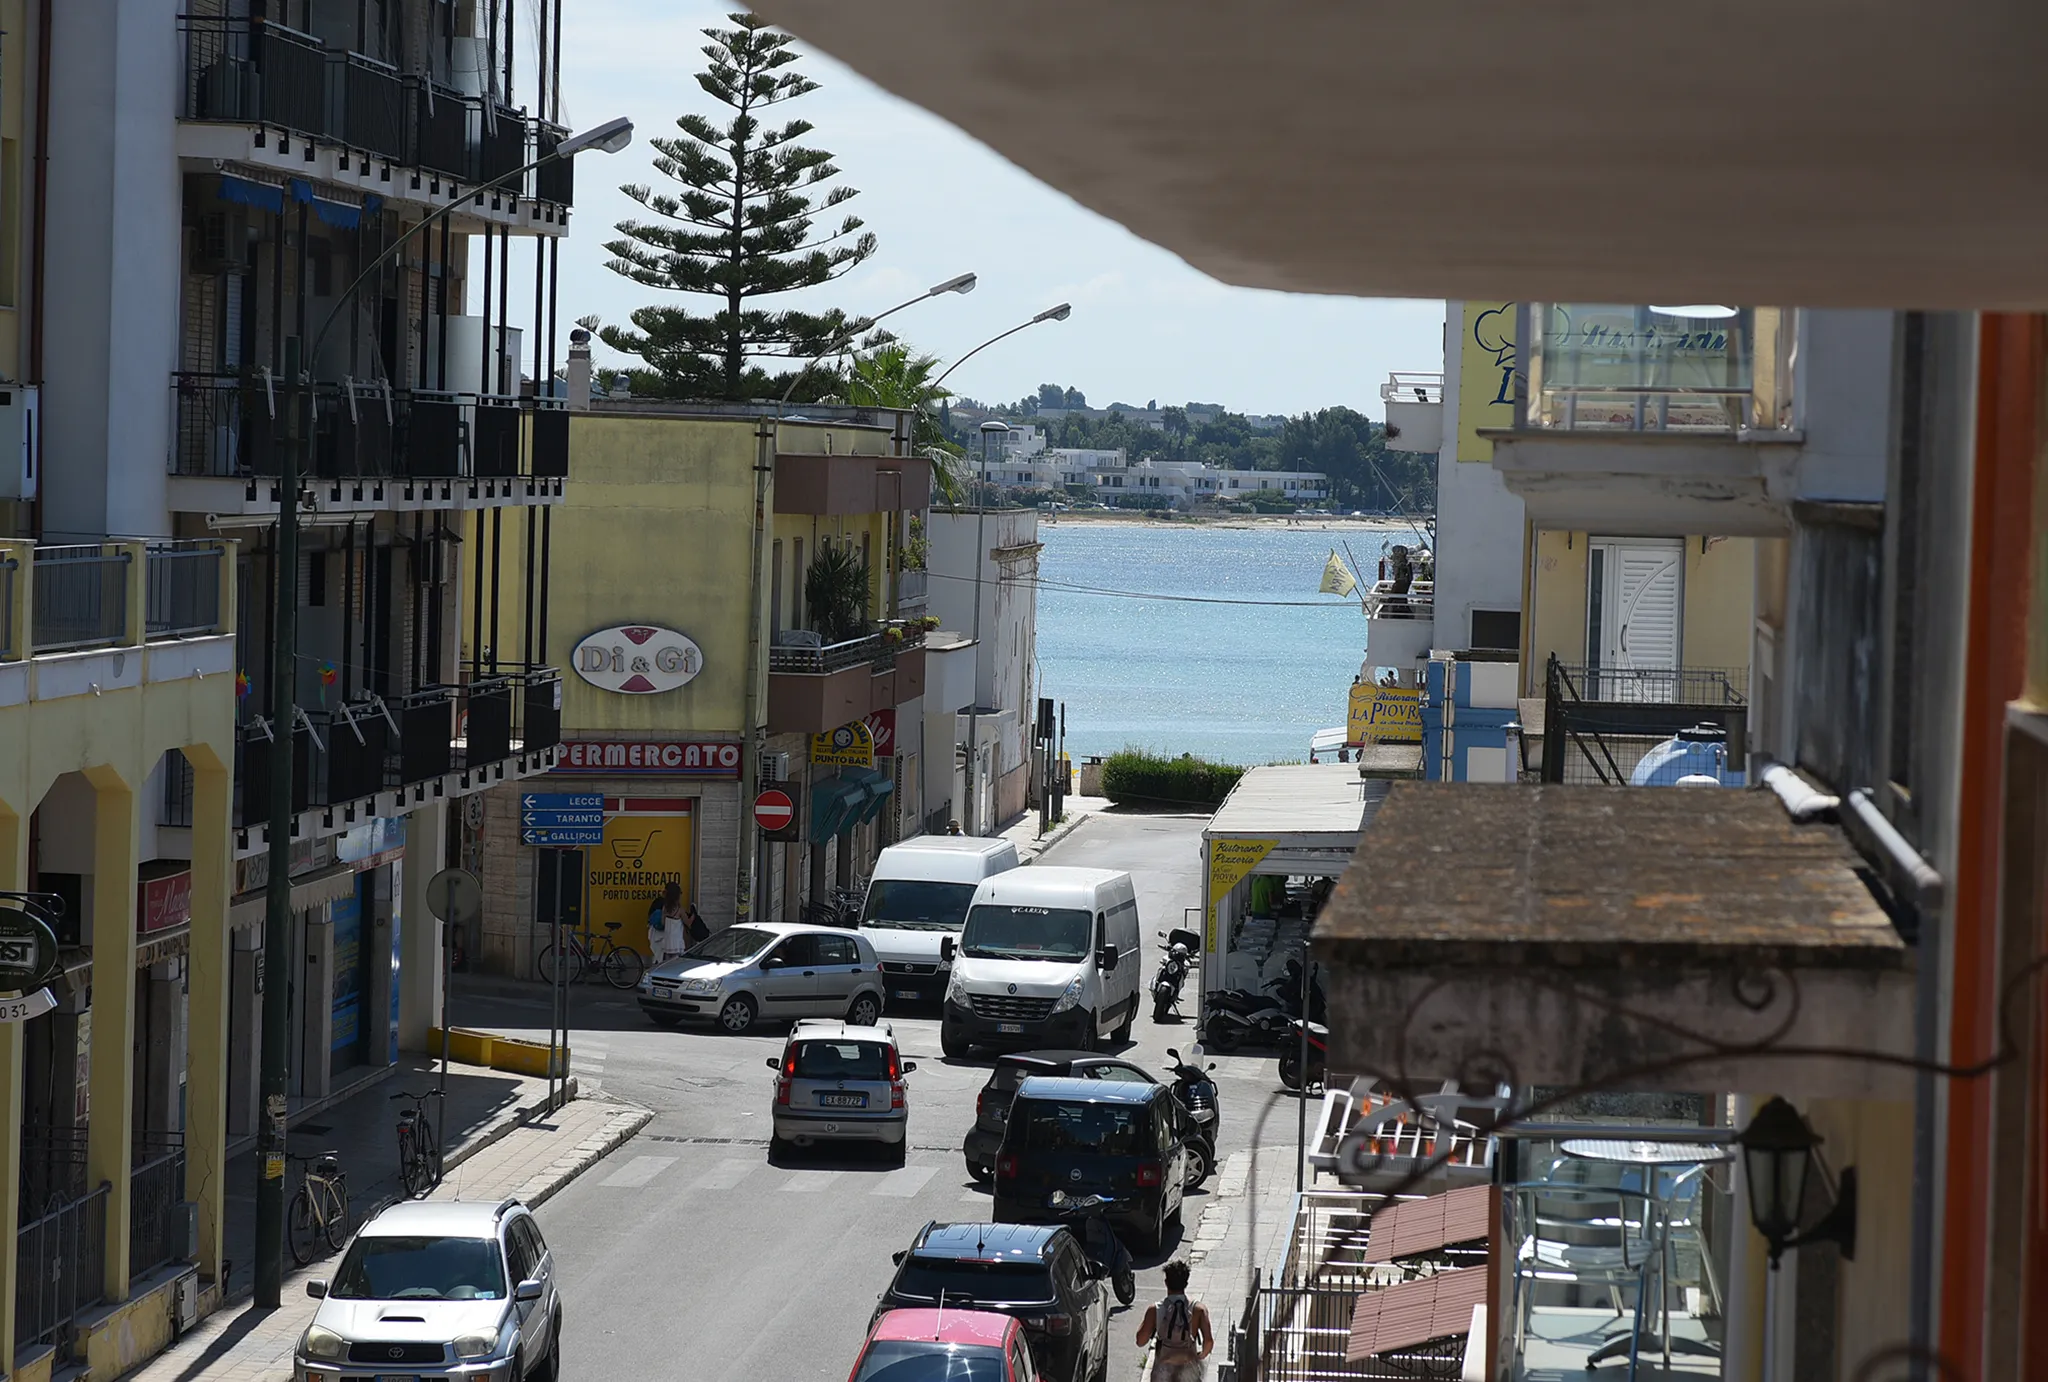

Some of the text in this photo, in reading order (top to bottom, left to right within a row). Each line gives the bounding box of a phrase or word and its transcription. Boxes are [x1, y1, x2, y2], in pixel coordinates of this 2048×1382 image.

[581, 646, 697, 673] Di & Gi
[1351, 709, 1368, 721] LA
[815, 755, 868, 766] PUNTO BAR
[569, 797, 602, 806] LECCE
[556, 814, 602, 824] TARANTO
[551, 832, 602, 841] GALLIPOLI
[1216, 842, 1265, 853] Ristorante
[1212, 853, 1255, 865] Pizzeria
[590, 871, 681, 886] SUPERMERCATO
[603, 890, 630, 900] PORTO
[12, 1004, 29, 1018] 32
[827, 1124, 836, 1132] CH
